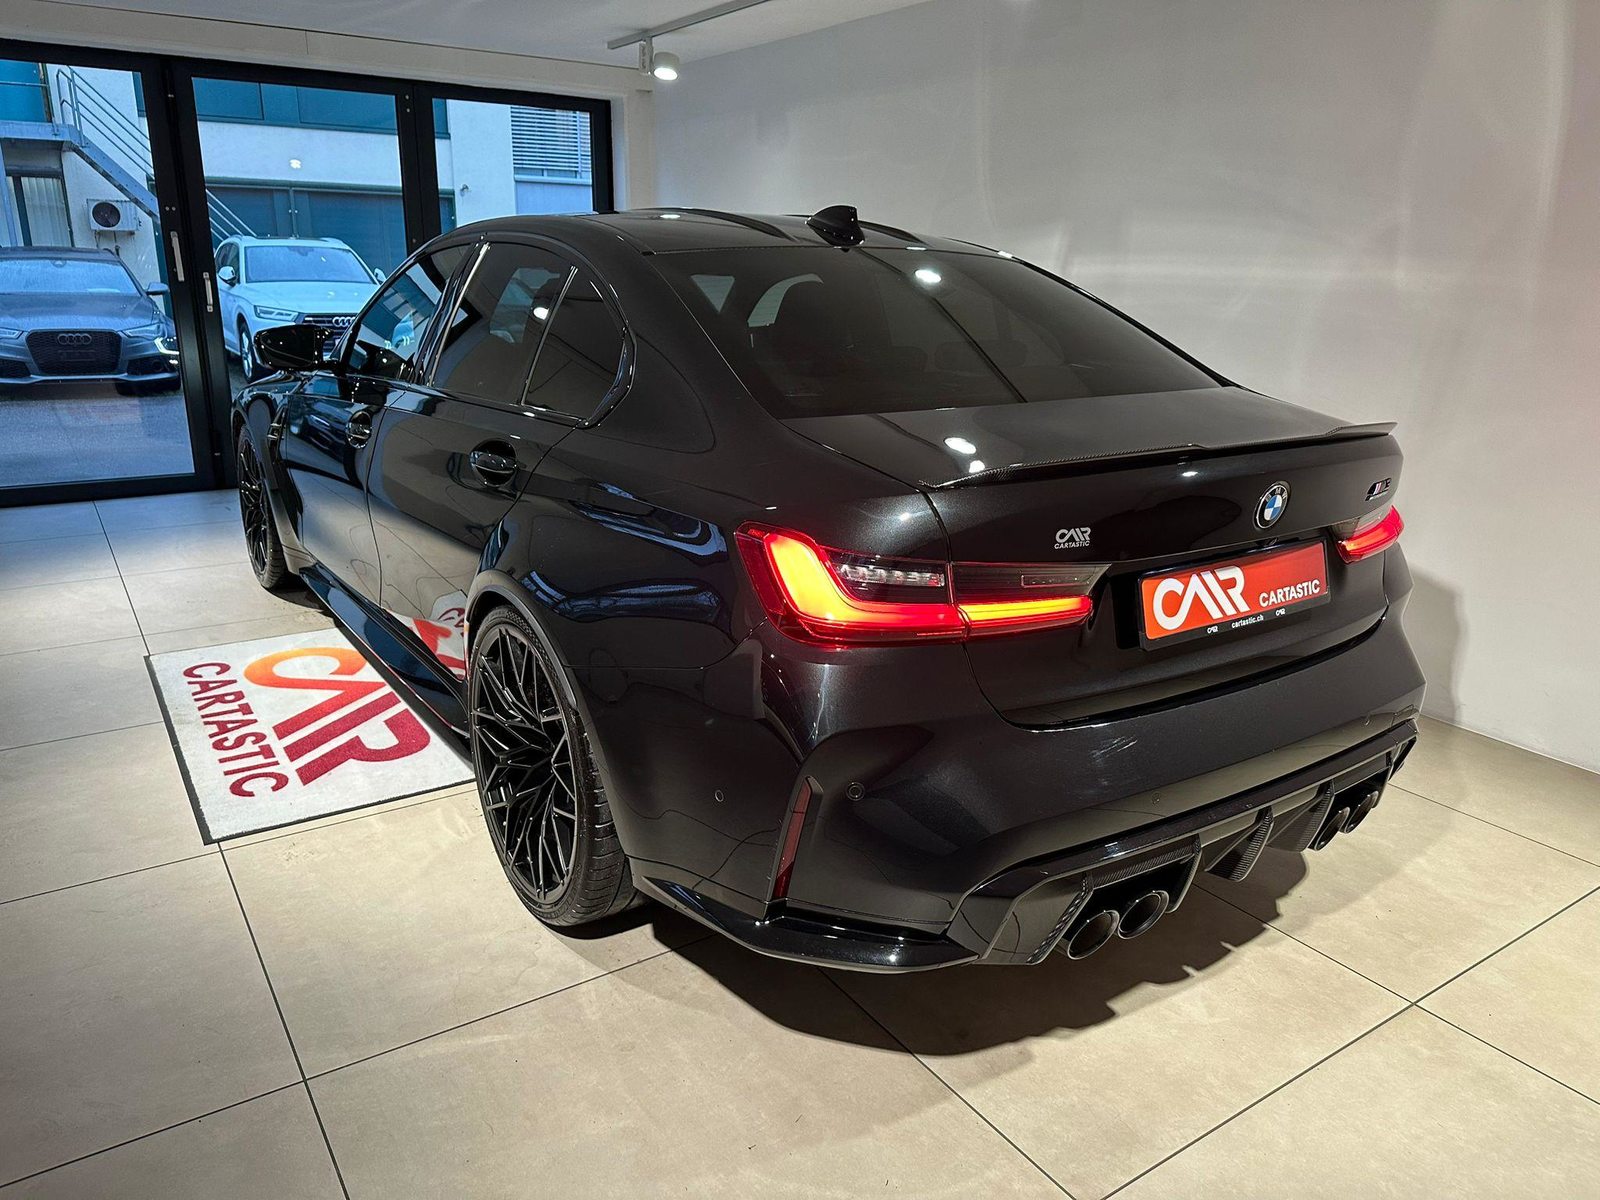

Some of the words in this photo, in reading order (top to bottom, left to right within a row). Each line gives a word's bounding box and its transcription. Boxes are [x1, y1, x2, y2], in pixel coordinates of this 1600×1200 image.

[1054, 541, 1091, 550] CARTASTIC
[1259, 580, 1320, 607] CARTASTIC
[1231, 614, 1264, 629] cartastic.ch
[182, 662, 289, 798] CARTASTIC
